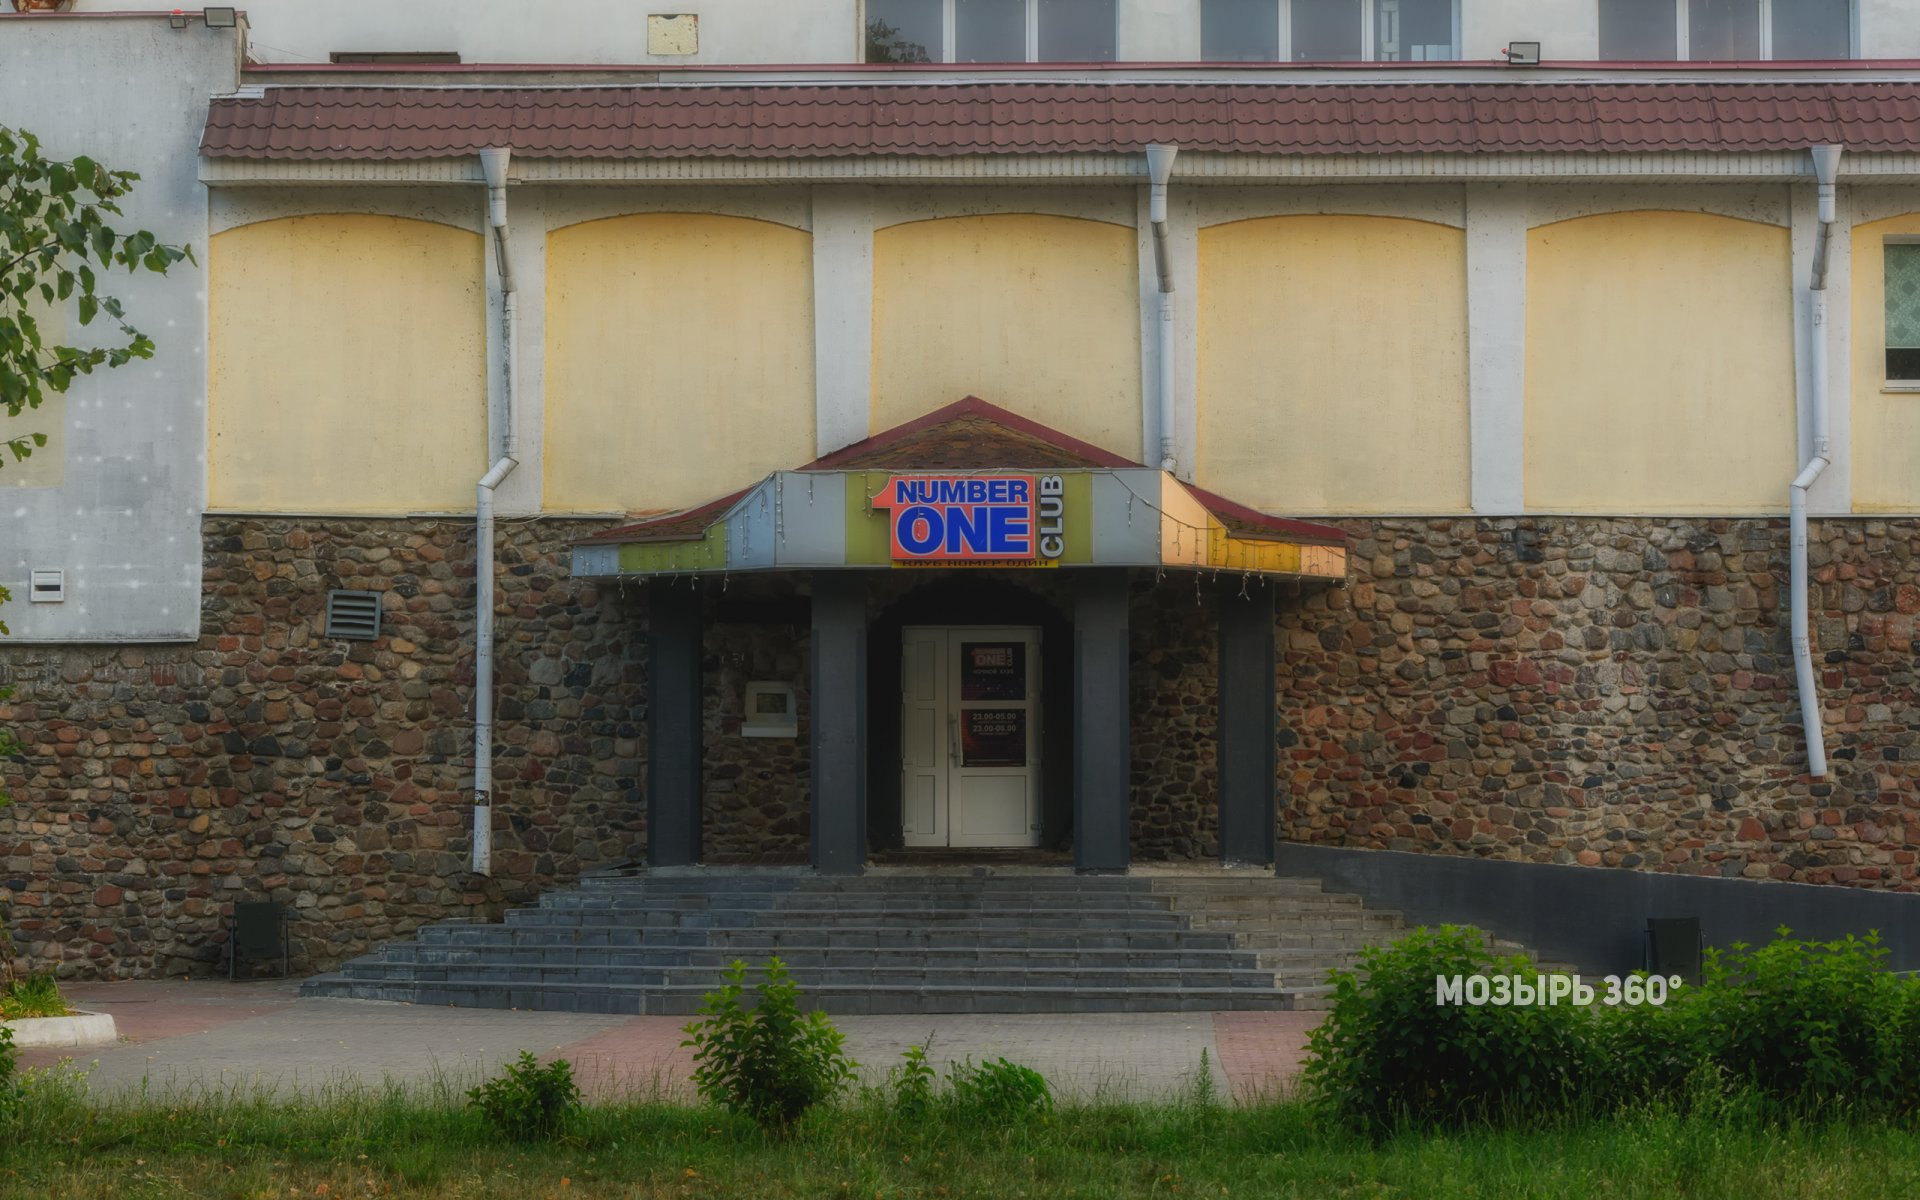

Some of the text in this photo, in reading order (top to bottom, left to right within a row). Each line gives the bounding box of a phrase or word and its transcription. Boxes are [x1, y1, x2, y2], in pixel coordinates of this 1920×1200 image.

[896, 479, 1030, 504] NUMBER
[1040, 474, 1064, 559] CLUB
[896, 505, 1030, 556] ONE
[1005, 559, 1048, 567] ОДИН
[975, 654, 1006, 666] ONE
